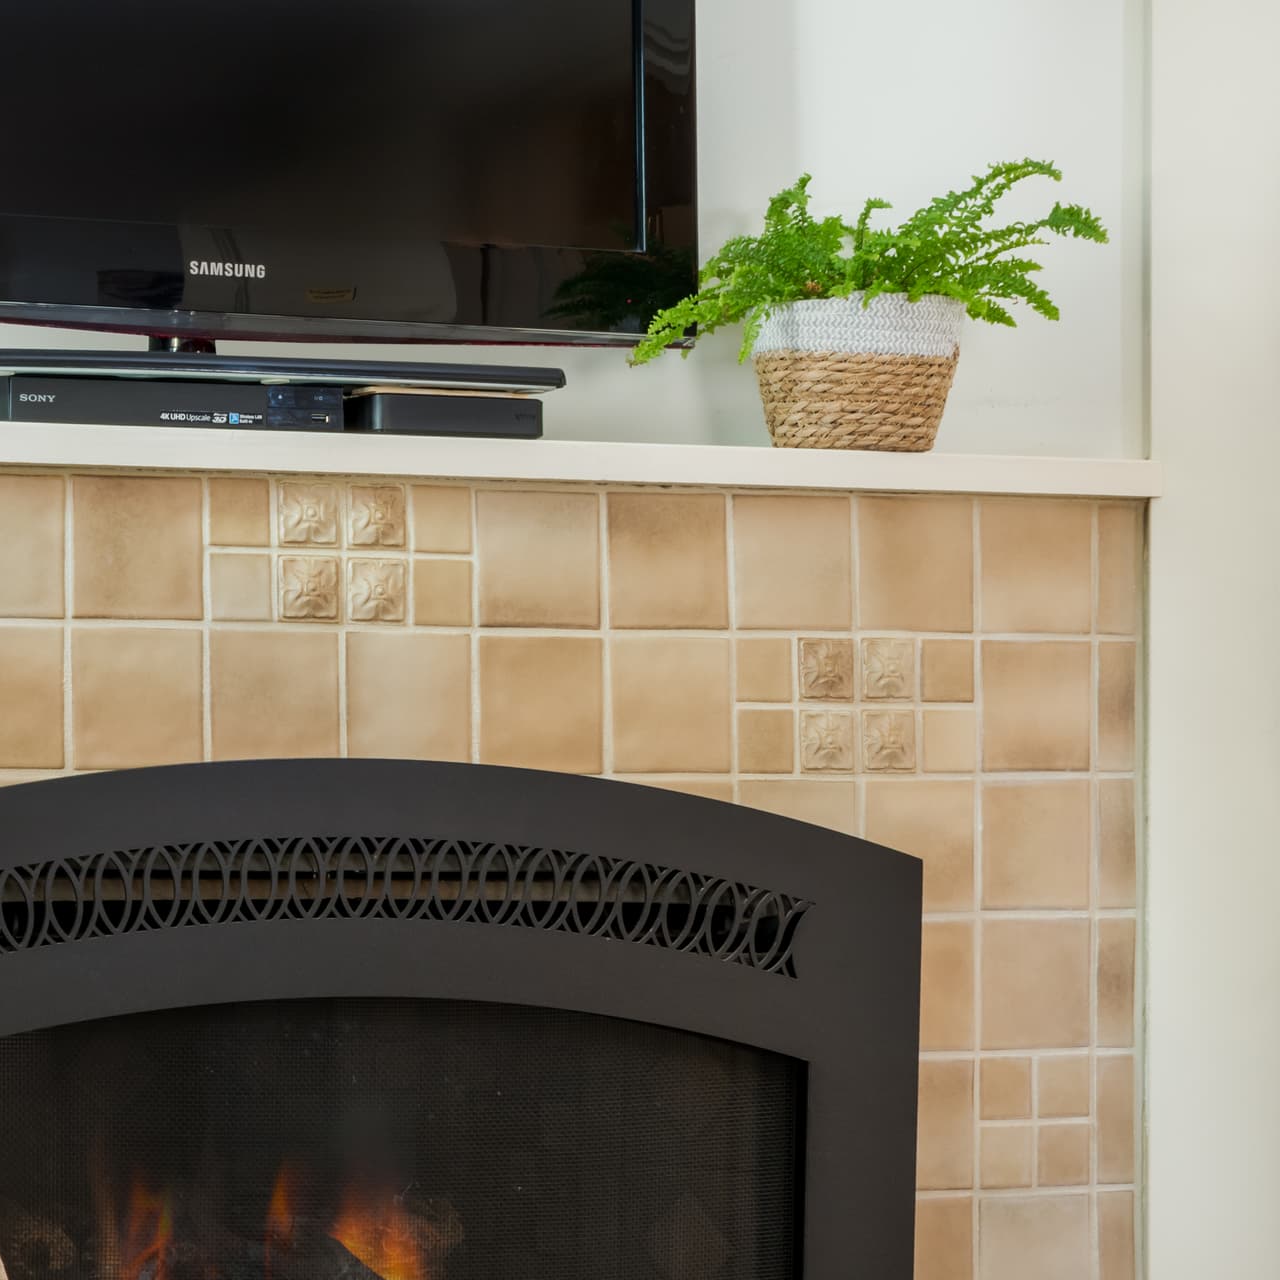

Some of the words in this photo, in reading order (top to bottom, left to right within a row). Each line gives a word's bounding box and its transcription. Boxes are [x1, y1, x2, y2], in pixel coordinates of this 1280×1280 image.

[189, 260, 266, 279] SAMSUNG
[19, 393, 56, 403] SONY
[170, 413, 186, 421] UHD
[186, 414, 211, 423] Upscale
